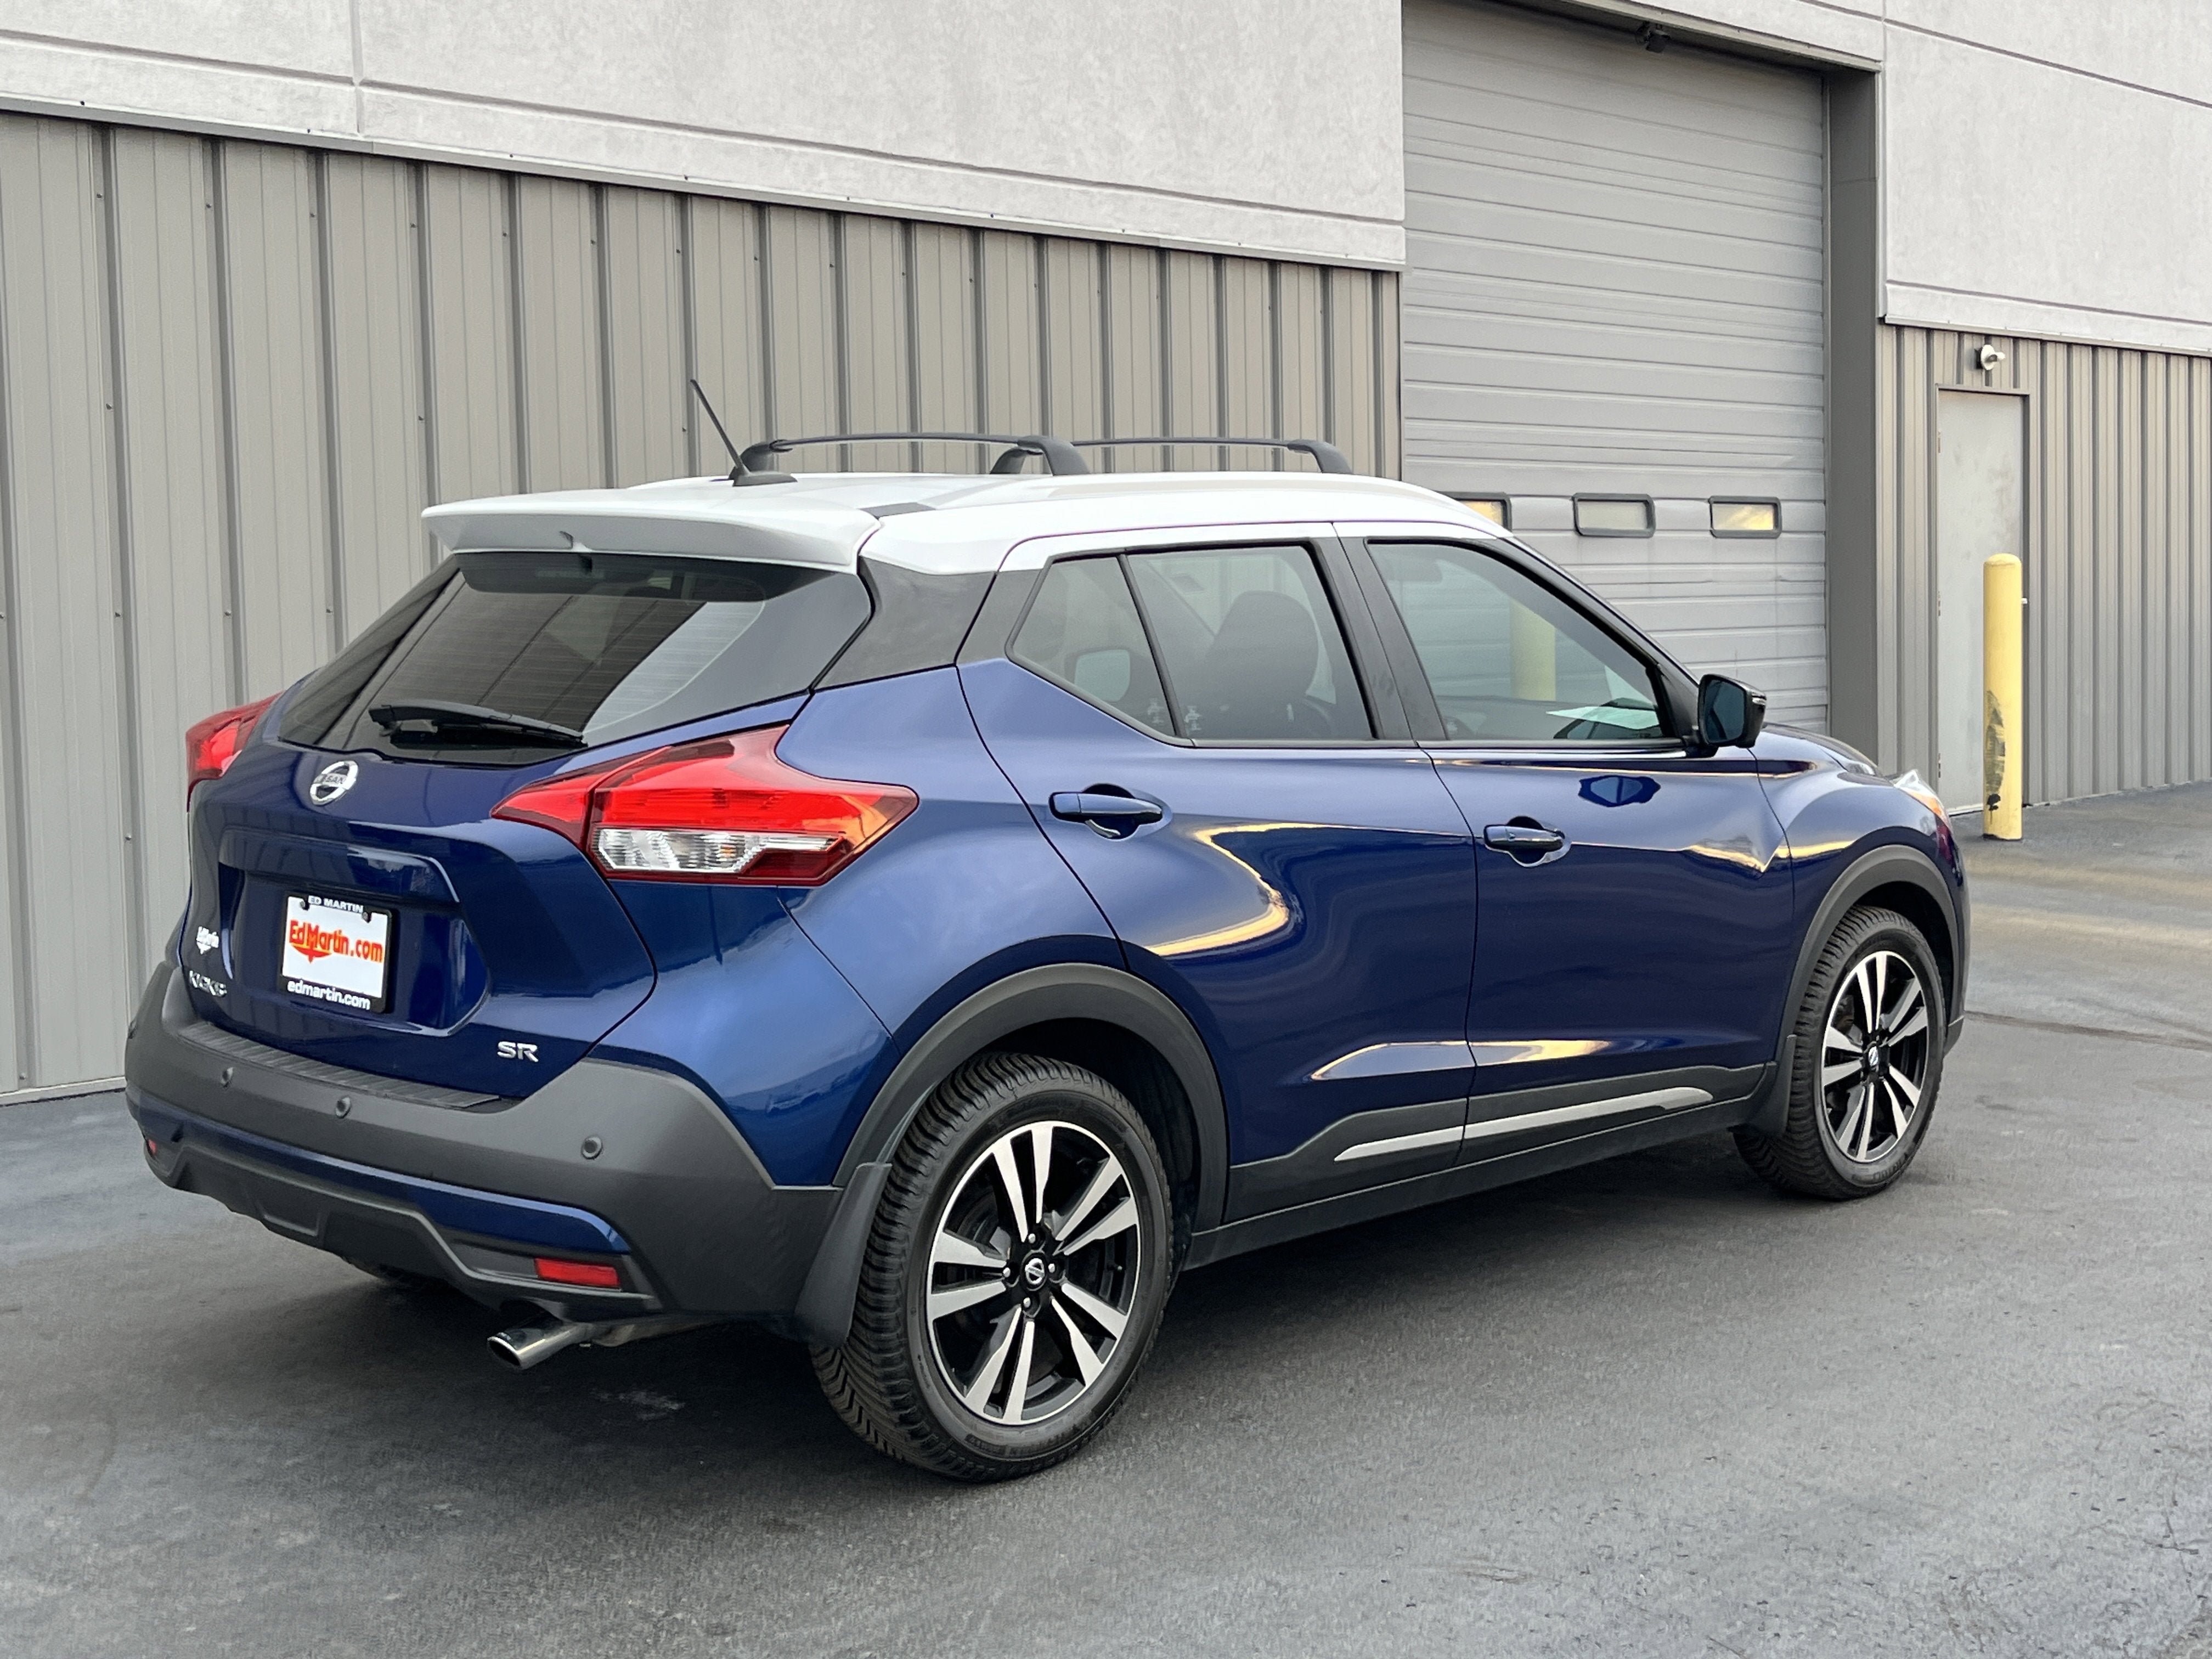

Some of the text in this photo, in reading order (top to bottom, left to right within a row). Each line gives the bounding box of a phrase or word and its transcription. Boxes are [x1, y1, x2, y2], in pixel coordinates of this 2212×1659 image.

[308, 895, 364, 913] ED MARTIN
[289, 919, 382, 963] EdMartin.com
[287, 980, 370, 1010] edmartin.com
[497, 1041, 539, 1062] SR
